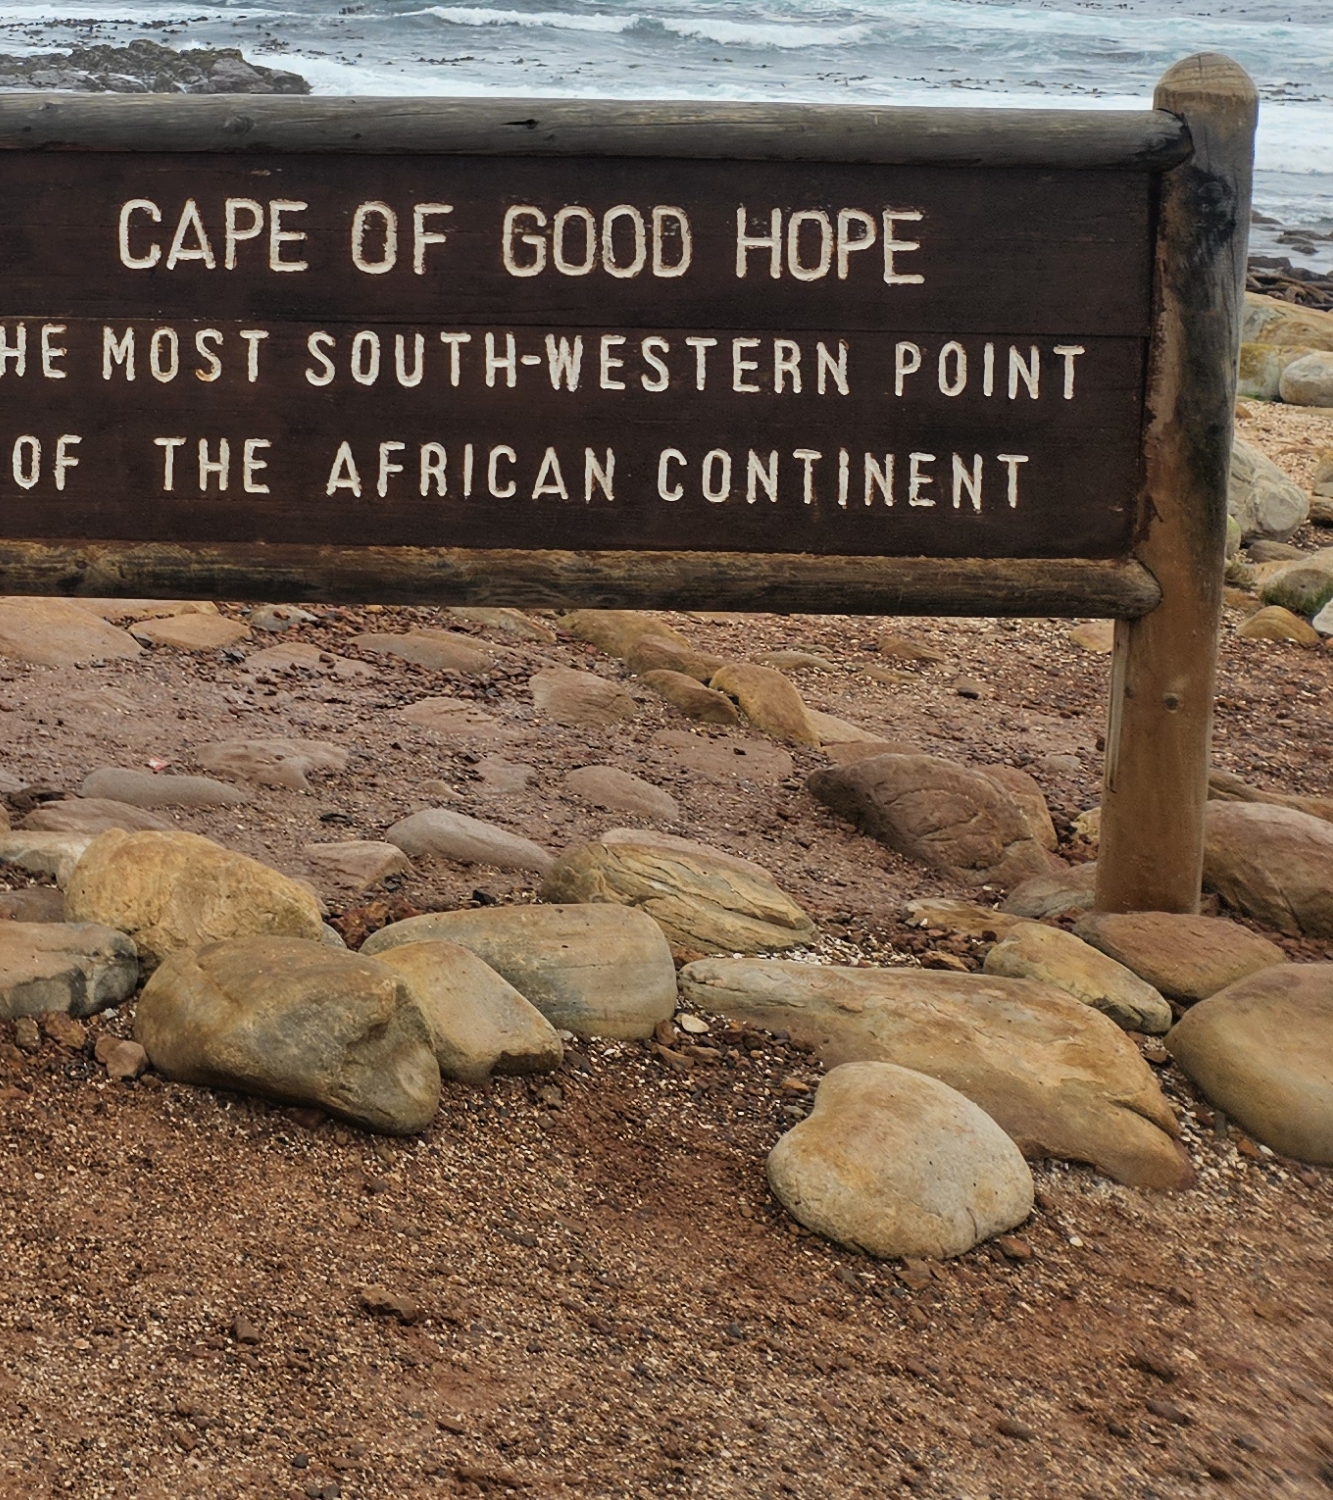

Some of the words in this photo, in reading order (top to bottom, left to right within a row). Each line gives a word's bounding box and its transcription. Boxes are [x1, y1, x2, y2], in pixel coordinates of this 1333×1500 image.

[118, 196, 309, 273] CAPE
[350, 199, 455, 276] OF
[500, 203, 693, 280] GOOD
[735, 206, 926, 285] HOPE
[101, 325, 270, 384] MOST
[304, 329, 851, 397] SOUTH-WESTERN
[893, 339, 1087, 401] POINT
[11, 433, 84, 492] OF
[153, 436, 273, 495] THE
[325, 440, 617, 503] AFRICAN
[656, 447, 1030, 512] CONTINENT
